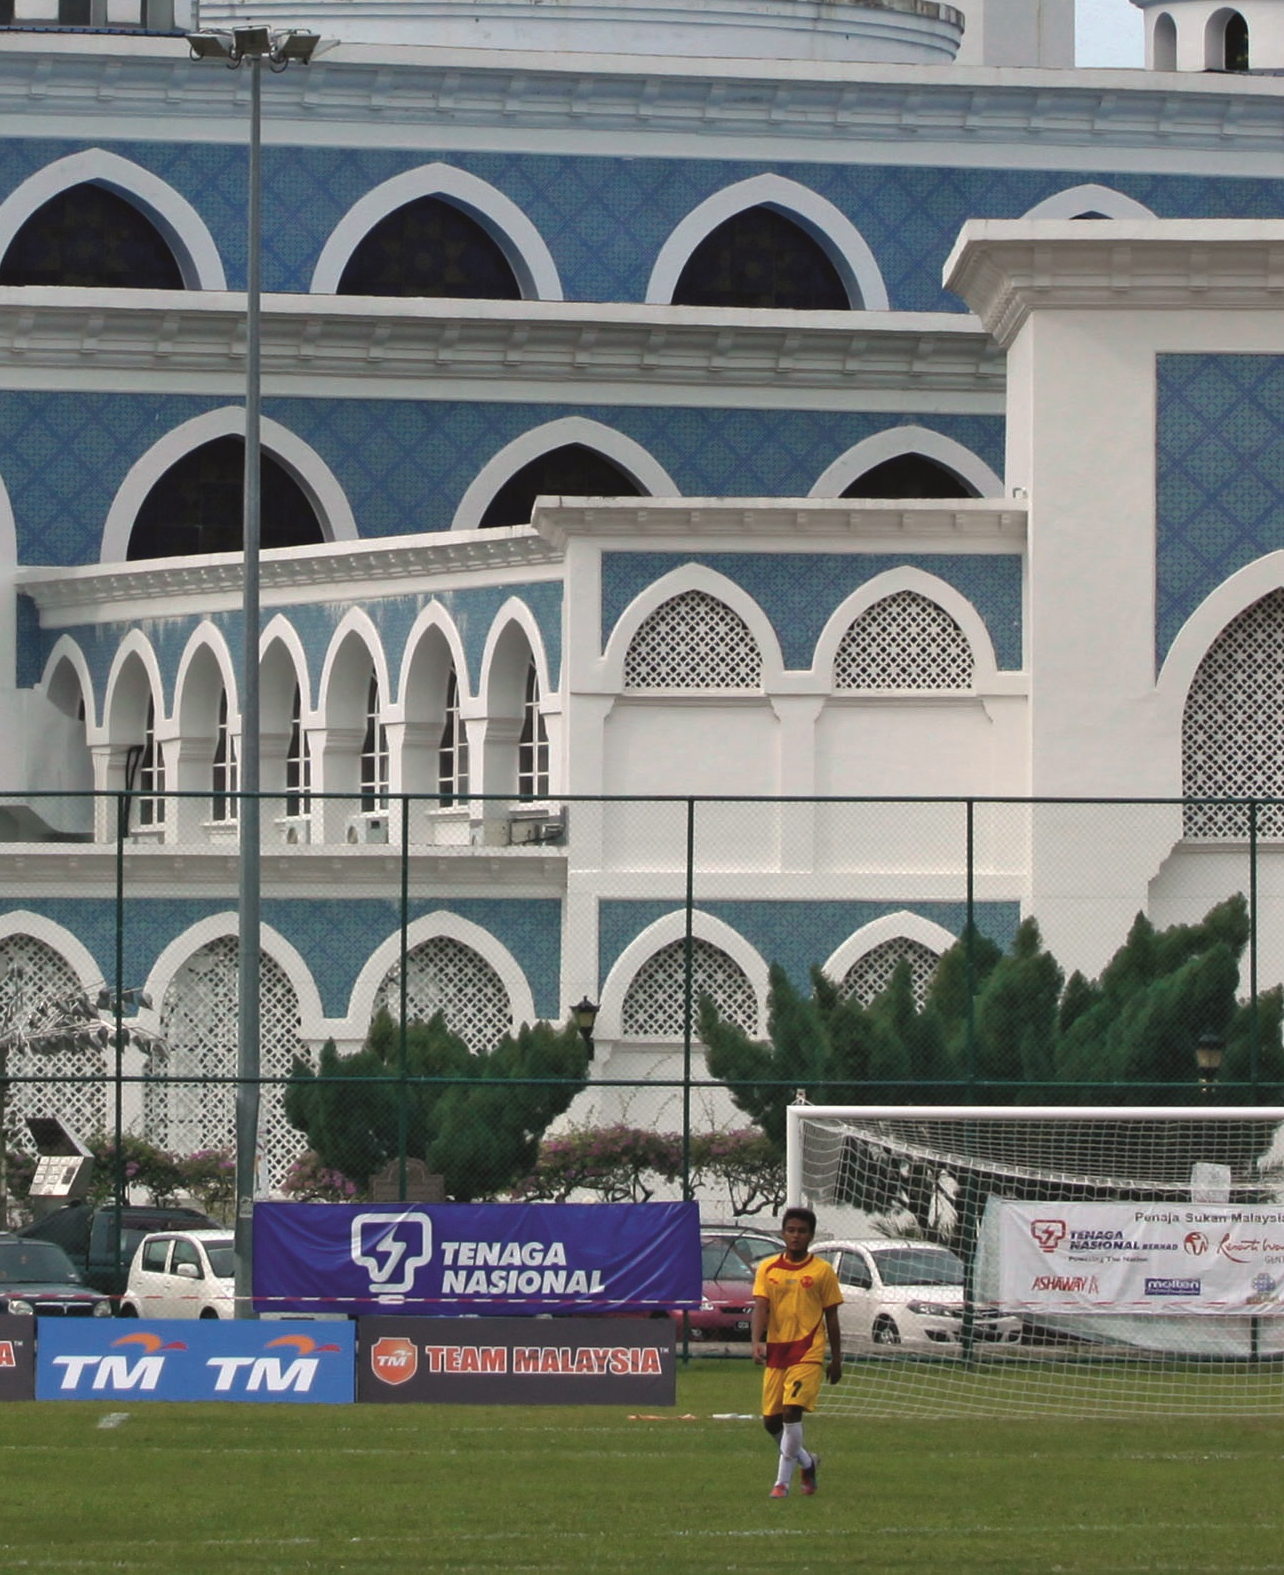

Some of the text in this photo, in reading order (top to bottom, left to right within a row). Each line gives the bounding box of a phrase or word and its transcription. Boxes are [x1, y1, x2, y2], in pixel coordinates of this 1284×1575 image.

[1135, 1212, 1179, 1225] Penaja
[1185, 1212, 1226, 1223] Sukan
[1070, 1230, 1124, 1240] TENAGA
[440, 1242, 567, 1267] TENAGA
[1069, 1241, 1140, 1250] NASIONAL
[441, 1270, 606, 1294] NASIONAL
[1031, 1276, 1088, 1292] ASHAWAY
[377, 1355, 408, 1368] TM
[425, 1345, 507, 1374] TEAM
[53, 1355, 166, 1390] TM
[206, 1356, 319, 1392] TM
